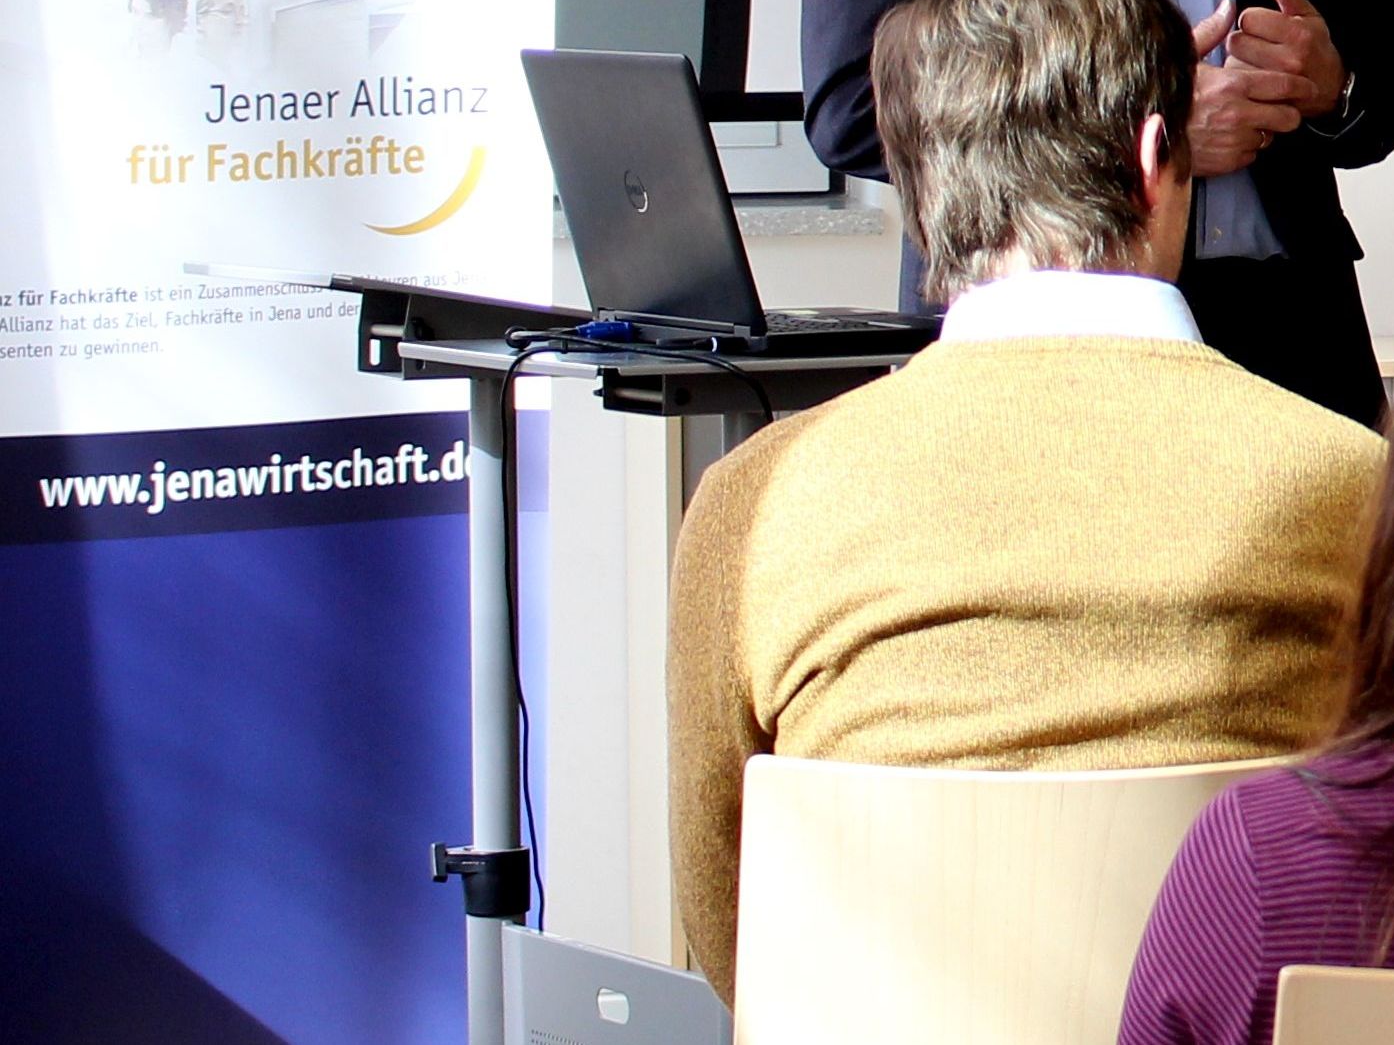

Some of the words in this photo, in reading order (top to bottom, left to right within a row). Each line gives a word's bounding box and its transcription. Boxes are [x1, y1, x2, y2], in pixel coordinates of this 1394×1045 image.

[205, 83, 340, 124] Jenaer
[350, 76, 489, 117] Allianz
[126, 143, 195, 184] für
[207, 135, 425, 182] Fachkräfte
[19, 290, 44, 306] für
[50, 288, 137, 305] Fachkräfte
[145, 287, 163, 302] ist
[170, 285, 193, 301] ein
[0, 315, 53, 332] Allianz
[60, 314, 86, 331] hat
[93, 313, 120, 330] das
[165, 308, 244, 327] Fachkräfte
[250, 306, 264, 322] in
[268, 305, 302, 321] Jena
[308, 302, 333, 319] und
[60, 344, 78, 357] zu
